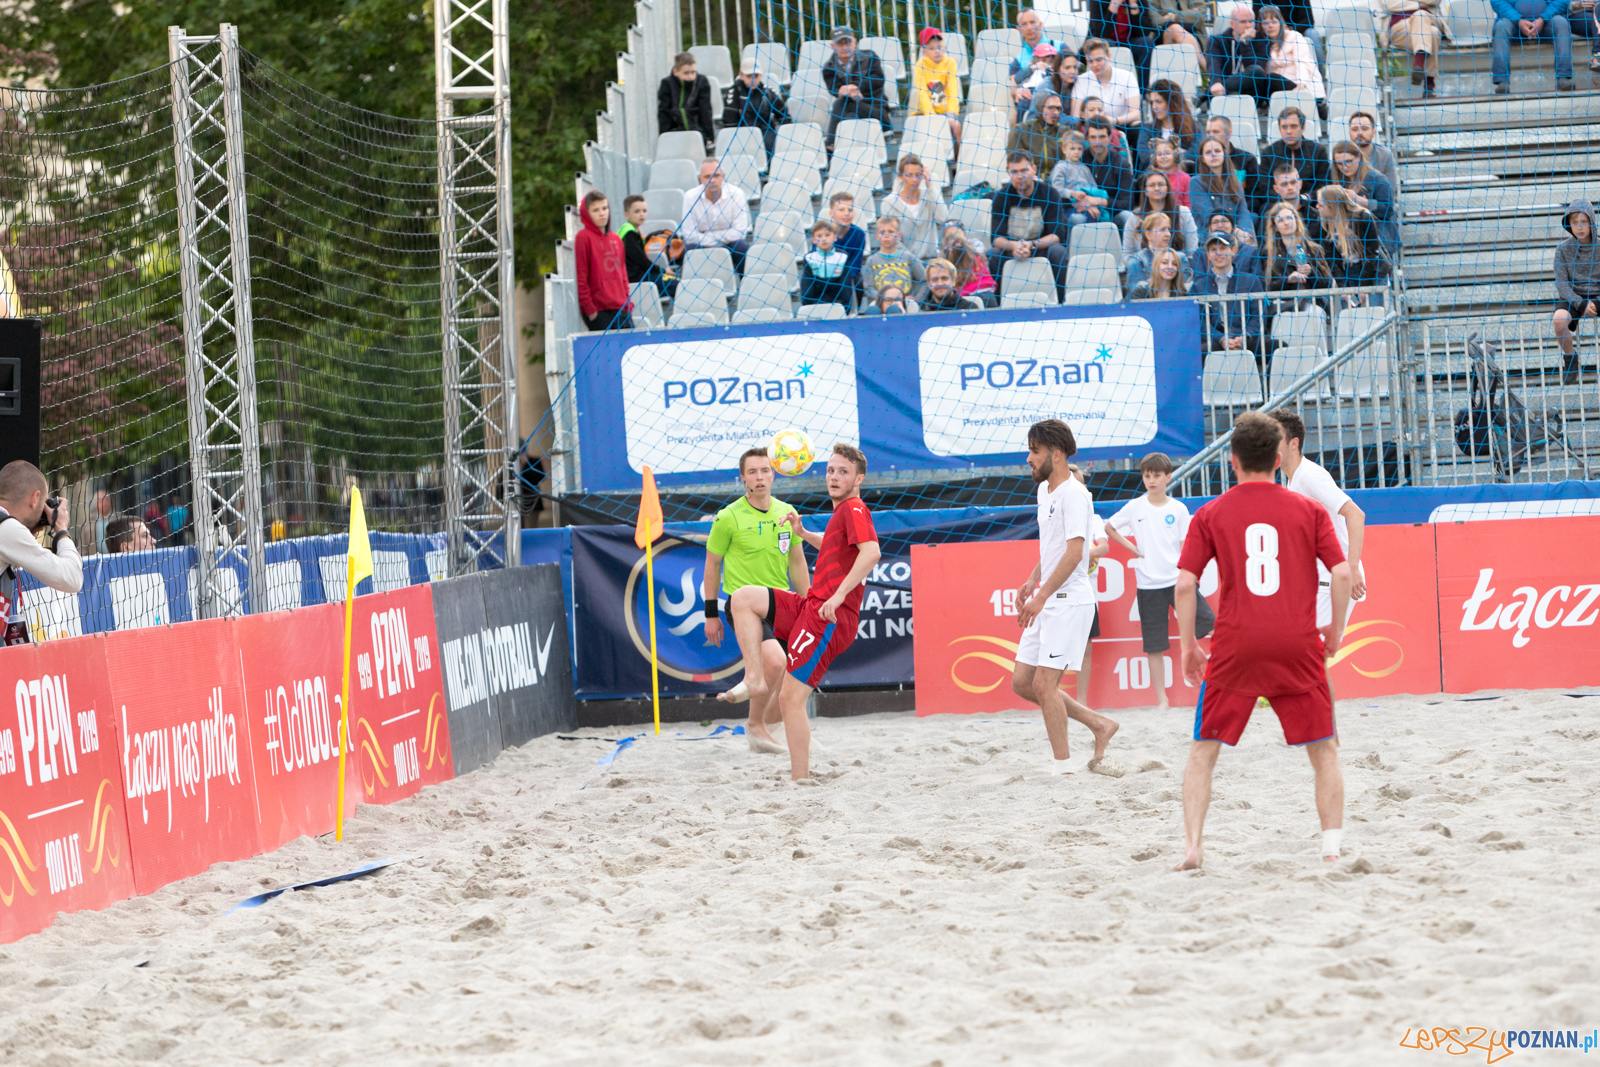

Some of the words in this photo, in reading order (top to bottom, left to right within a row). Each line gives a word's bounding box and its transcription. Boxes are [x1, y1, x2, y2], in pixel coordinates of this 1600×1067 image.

[1244, 522, 1280, 597] 8
[357, 652, 373, 690] 1919
[370, 607, 415, 699] PZPN
[414, 635, 431, 672] 2019
[791, 628, 815, 654] 17
[15, 673, 78, 787] PZPN
[77, 709, 99, 754] 2019
[121, 704, 172, 833] Łączy
[172, 721, 200, 798] nas
[200, 686, 241, 824] piłka
[393, 740, 409, 787] 100
[404, 737, 420, 783] LAT
[45, 837, 67, 895] 100
[63, 833, 84, 888] LAT
